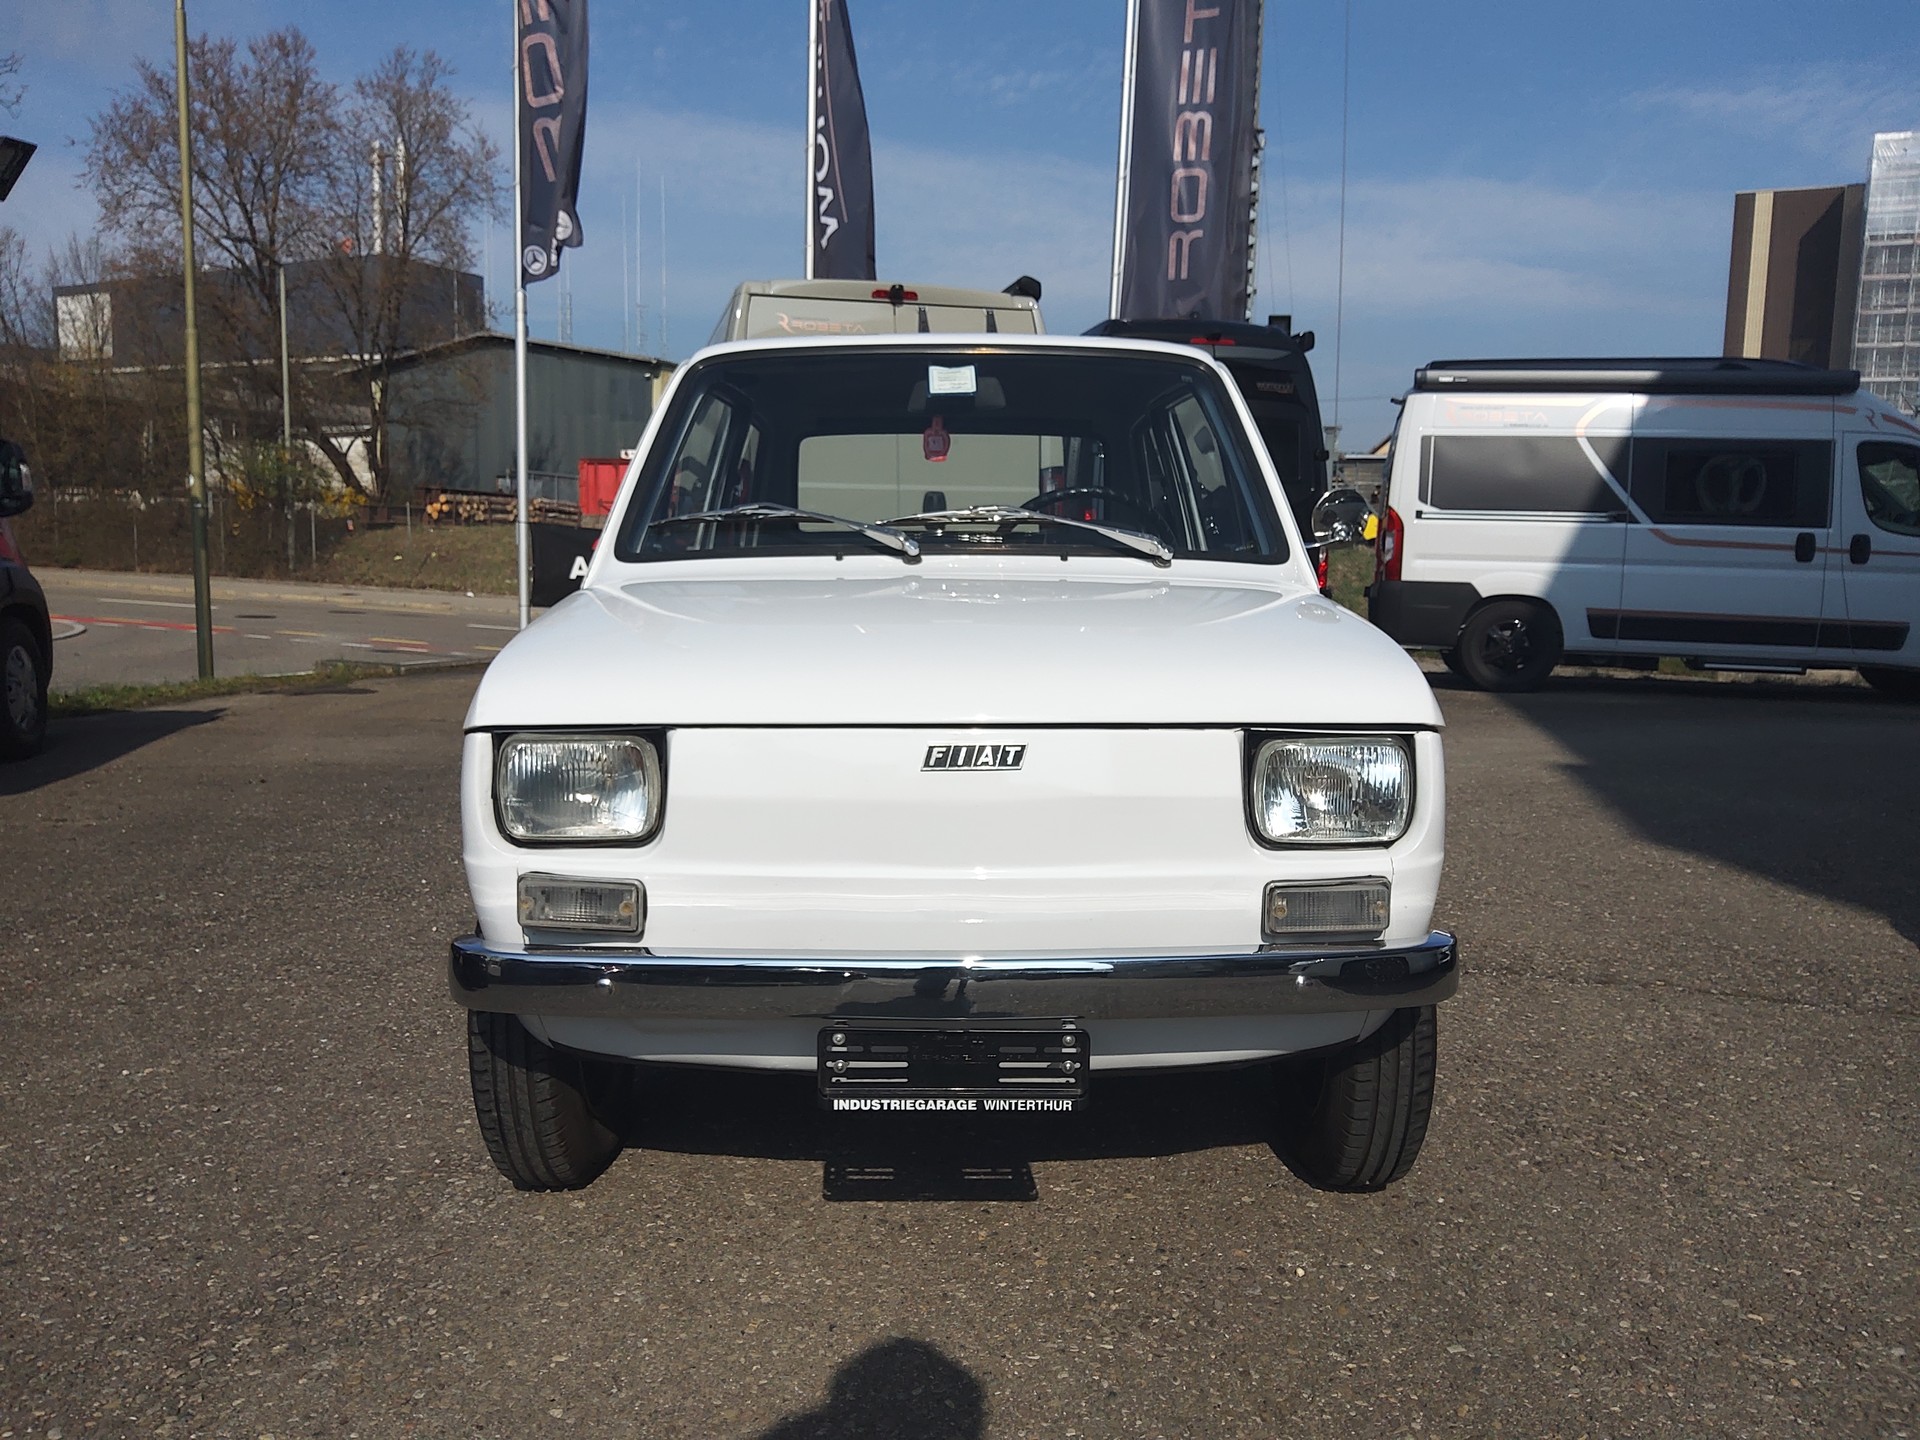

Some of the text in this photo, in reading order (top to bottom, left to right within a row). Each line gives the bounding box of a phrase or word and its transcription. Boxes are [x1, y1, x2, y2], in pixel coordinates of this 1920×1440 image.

[924, 745, 1025, 767] FIAT
[833, 1099, 1073, 1112] INDUSTRIEGARAGE WINTERTHUR
